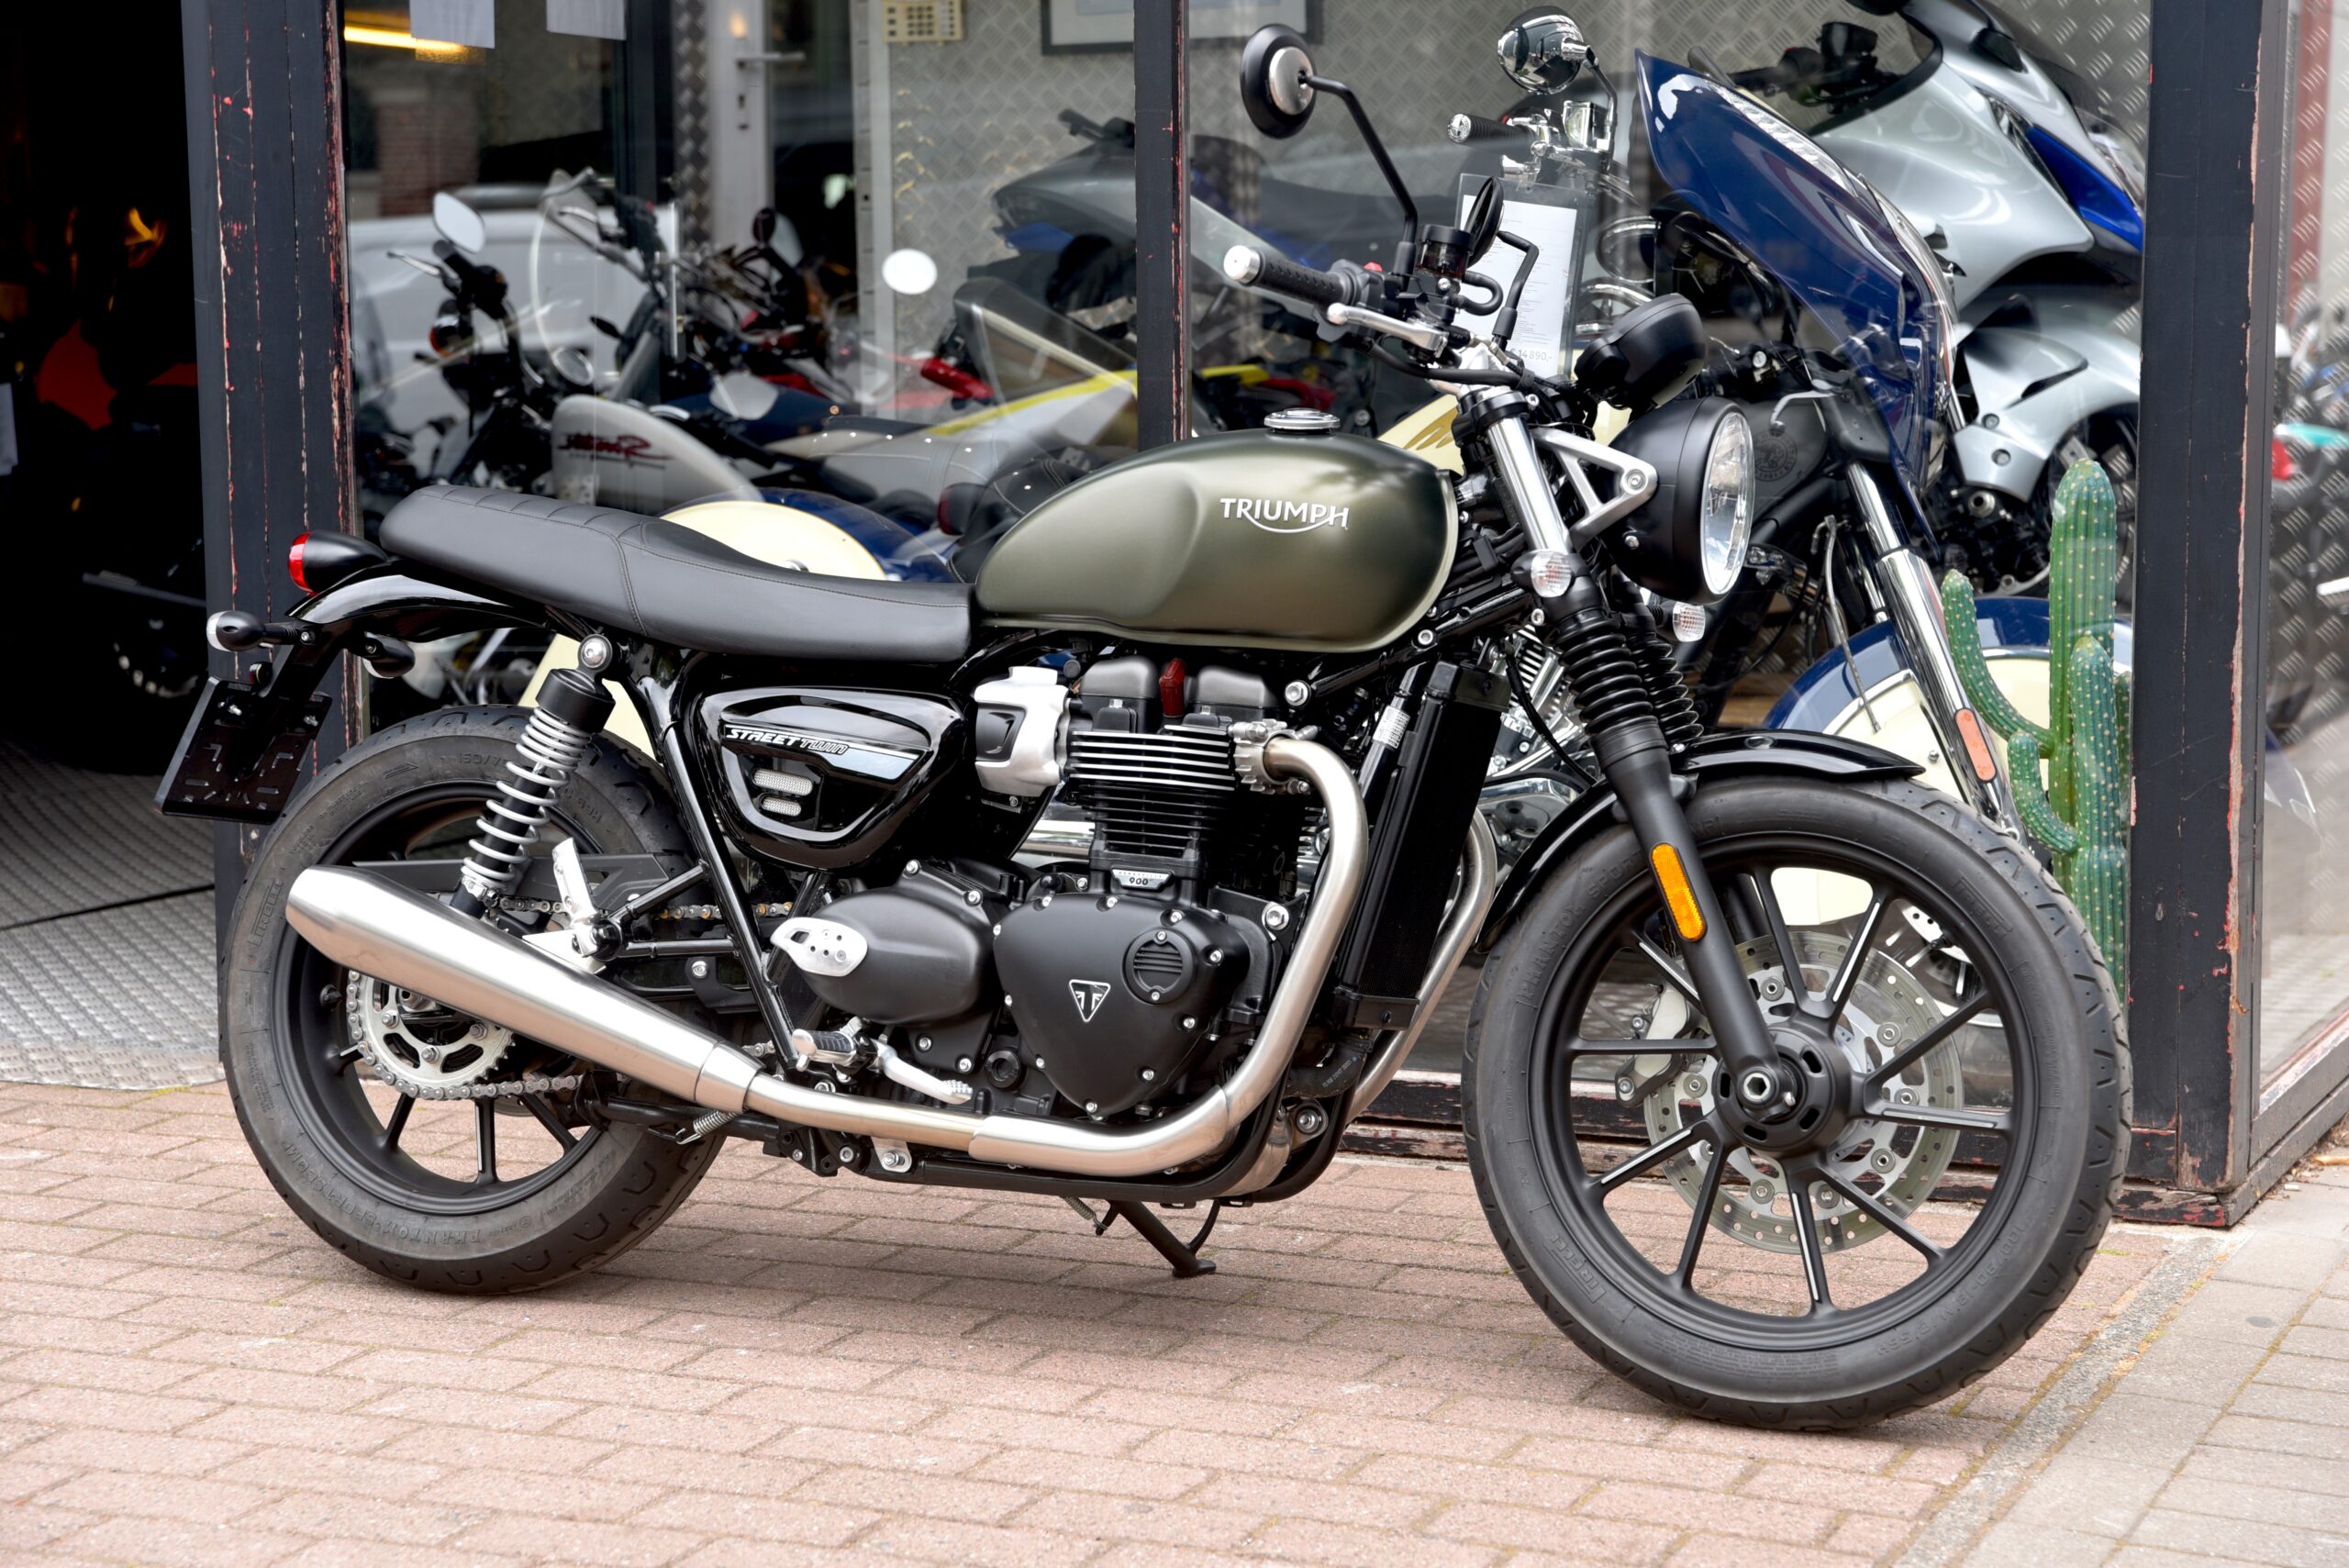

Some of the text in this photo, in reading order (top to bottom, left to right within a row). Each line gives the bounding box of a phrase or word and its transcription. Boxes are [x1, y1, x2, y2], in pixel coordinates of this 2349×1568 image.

[1220, 498, 1350, 533] TRIUMPH
[726, 728, 803, 747] STREET
[1129, 876, 1149, 885] 900
[1542, 1233, 1608, 1304] PIRELLI
